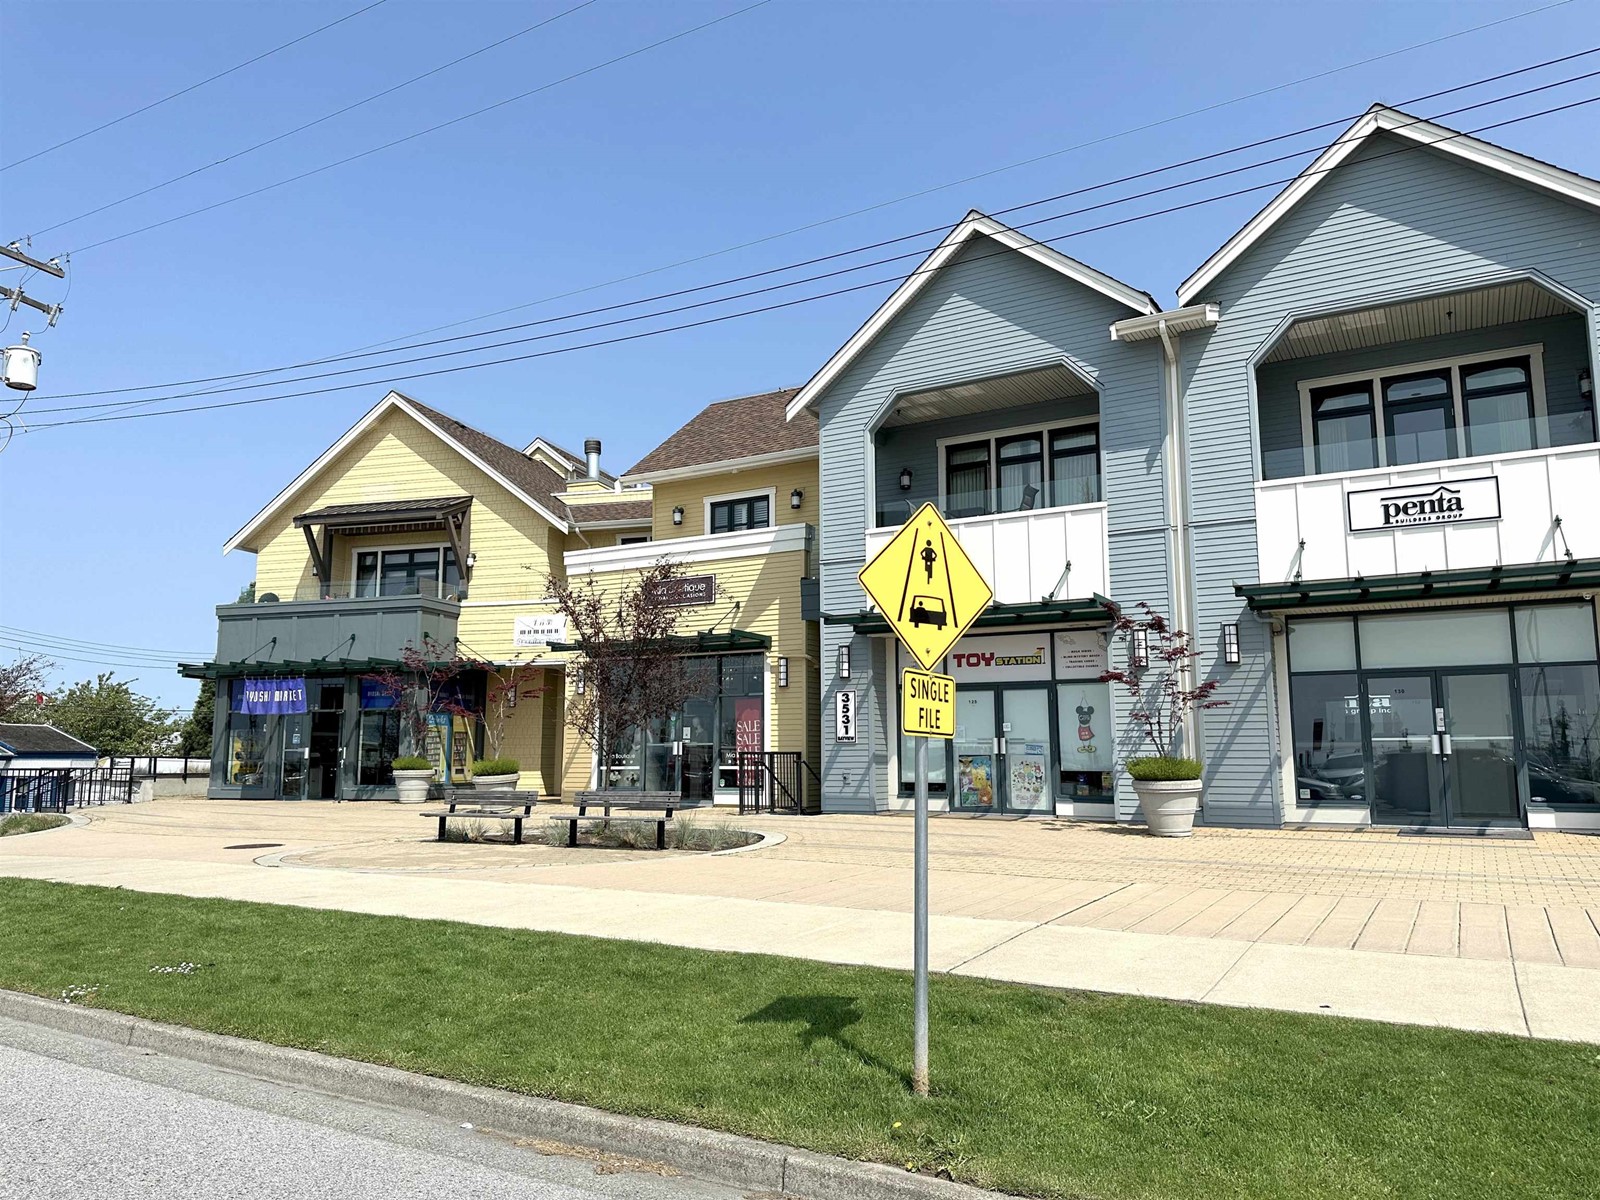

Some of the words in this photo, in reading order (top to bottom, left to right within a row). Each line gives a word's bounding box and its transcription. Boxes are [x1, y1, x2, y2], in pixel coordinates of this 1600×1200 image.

[1381, 492, 1464, 525] penta
[1395, 515, 1432, 524] BUILDERS
[1435, 513, 1463, 521] GROUP
[952, 652, 995, 668] TOY
[996, 656, 1041, 666] STATION
[910, 677, 949, 703] SINGLE
[841, 693, 850, 735] 3531
[919, 707, 940, 729] FILE
[1350, 707, 1376, 715] grp
[737, 720, 761, 732] SALE
[737, 732, 761, 744] SALE
